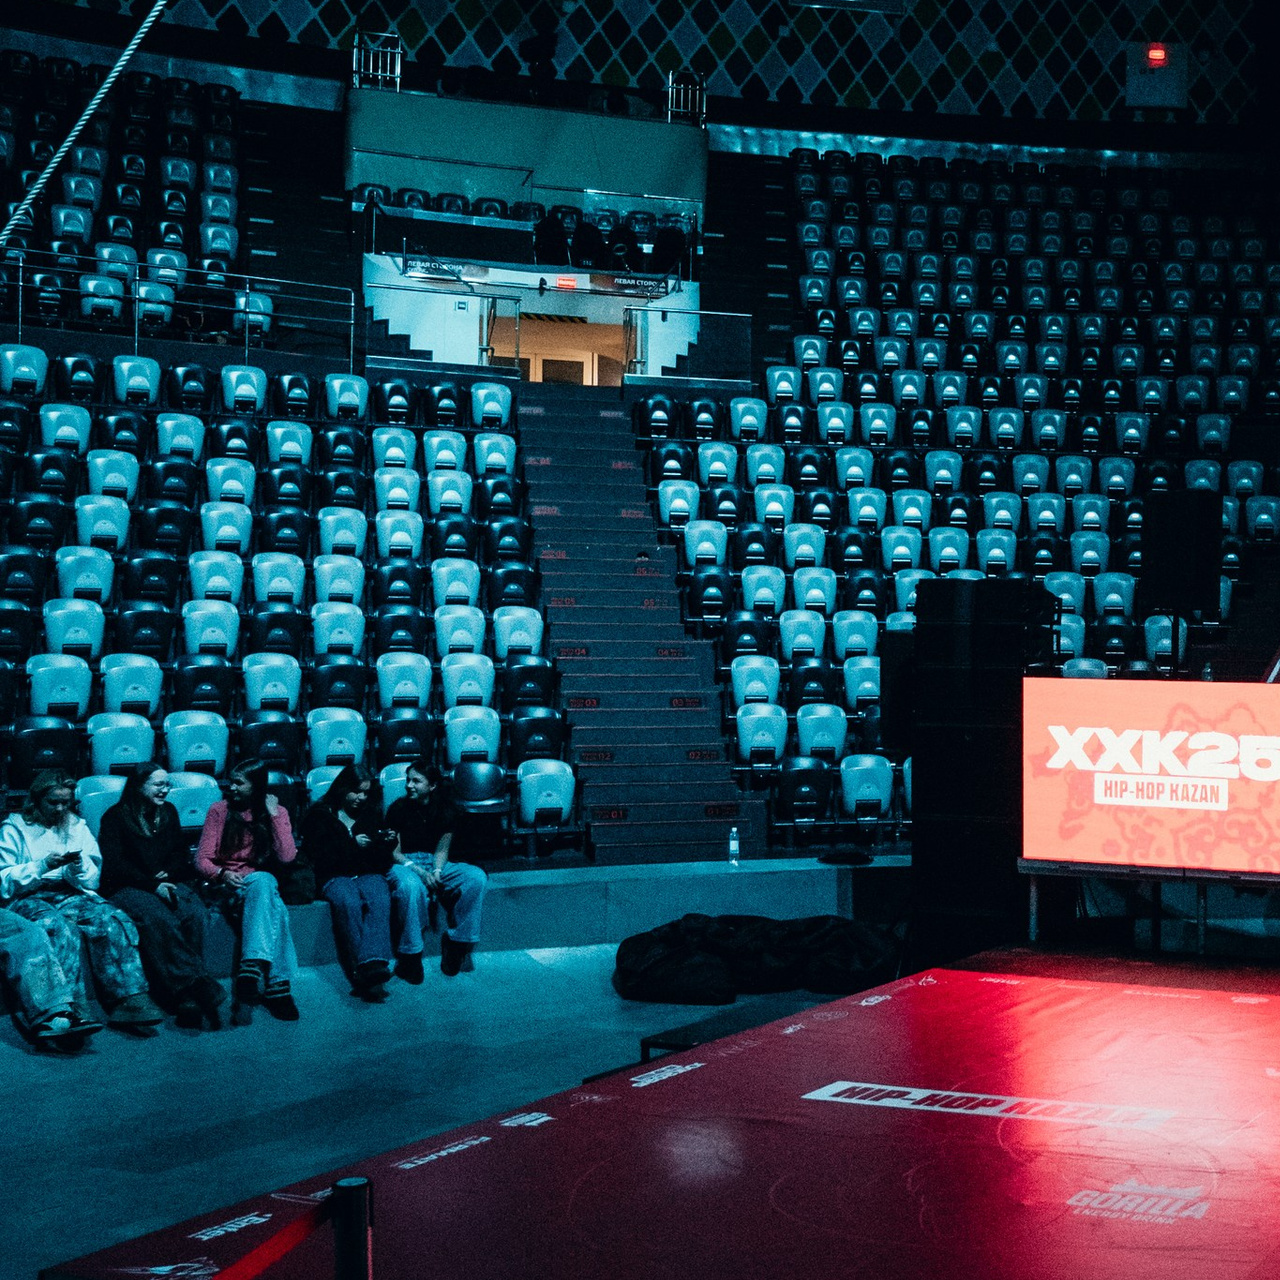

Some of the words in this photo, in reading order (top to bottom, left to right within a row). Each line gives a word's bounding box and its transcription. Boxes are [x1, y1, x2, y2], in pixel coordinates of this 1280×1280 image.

[1103, 779, 1165, 801] HIP-HOP
[1169, 783, 1220, 804] KAZAN
[831, 1085, 1006, 1113] HIP-HOP
[1066, 1188, 1211, 1220] GORILLA
